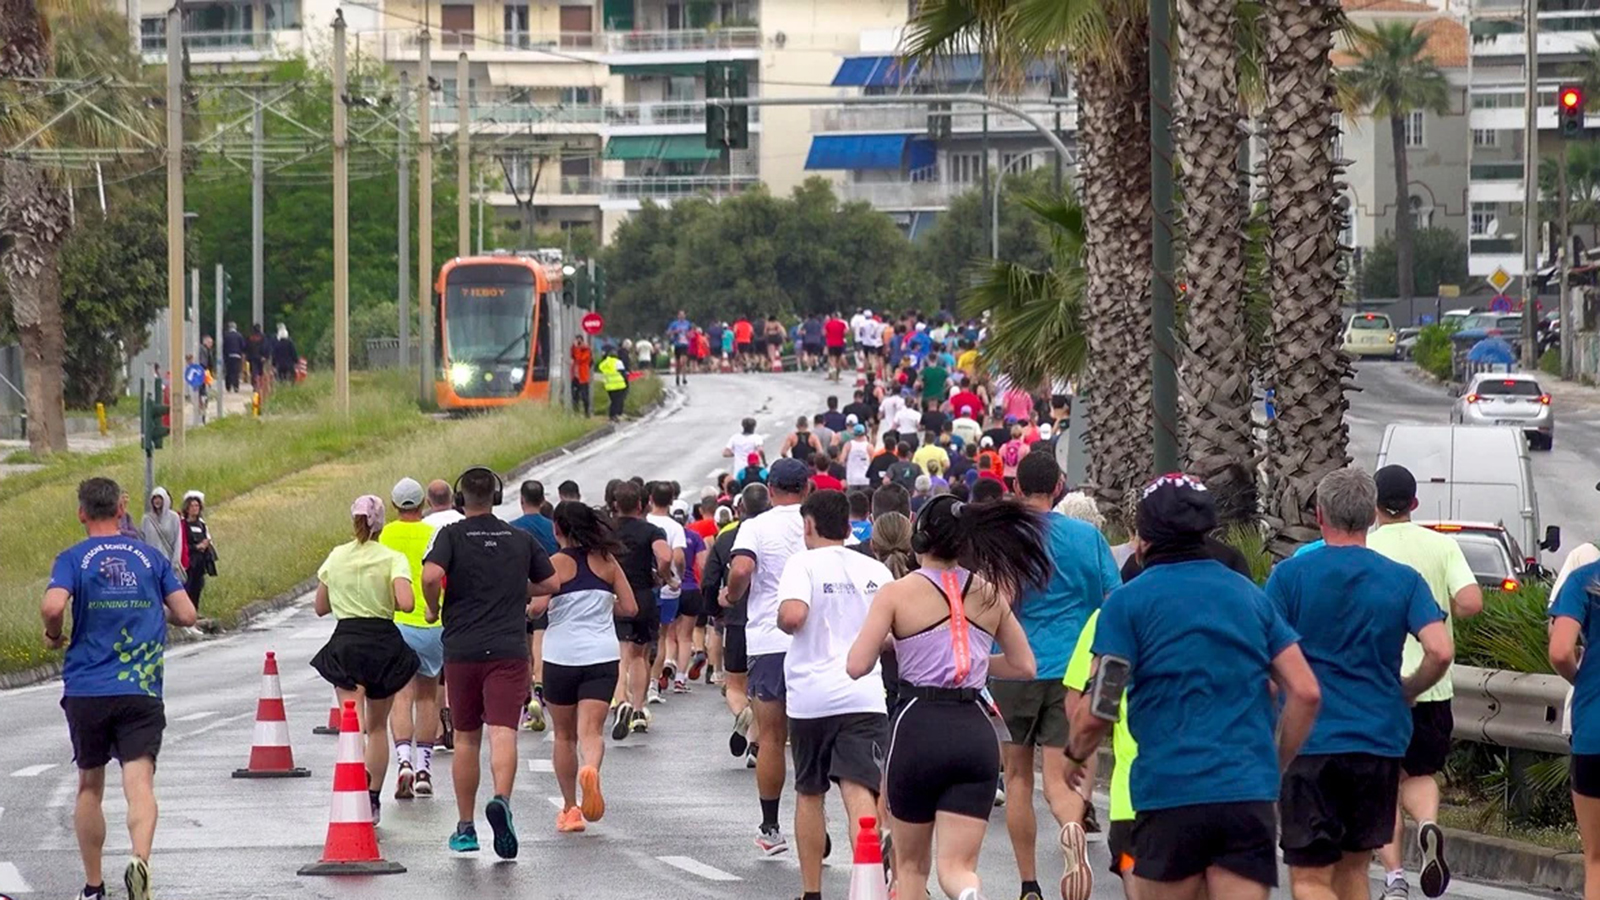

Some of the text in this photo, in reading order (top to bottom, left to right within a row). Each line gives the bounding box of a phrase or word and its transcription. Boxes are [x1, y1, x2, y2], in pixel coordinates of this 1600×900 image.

[81, 543, 151, 569] DEUTSCHE SCHULE ATHEN
[88, 600, 152, 609] RUNNING TEAM
